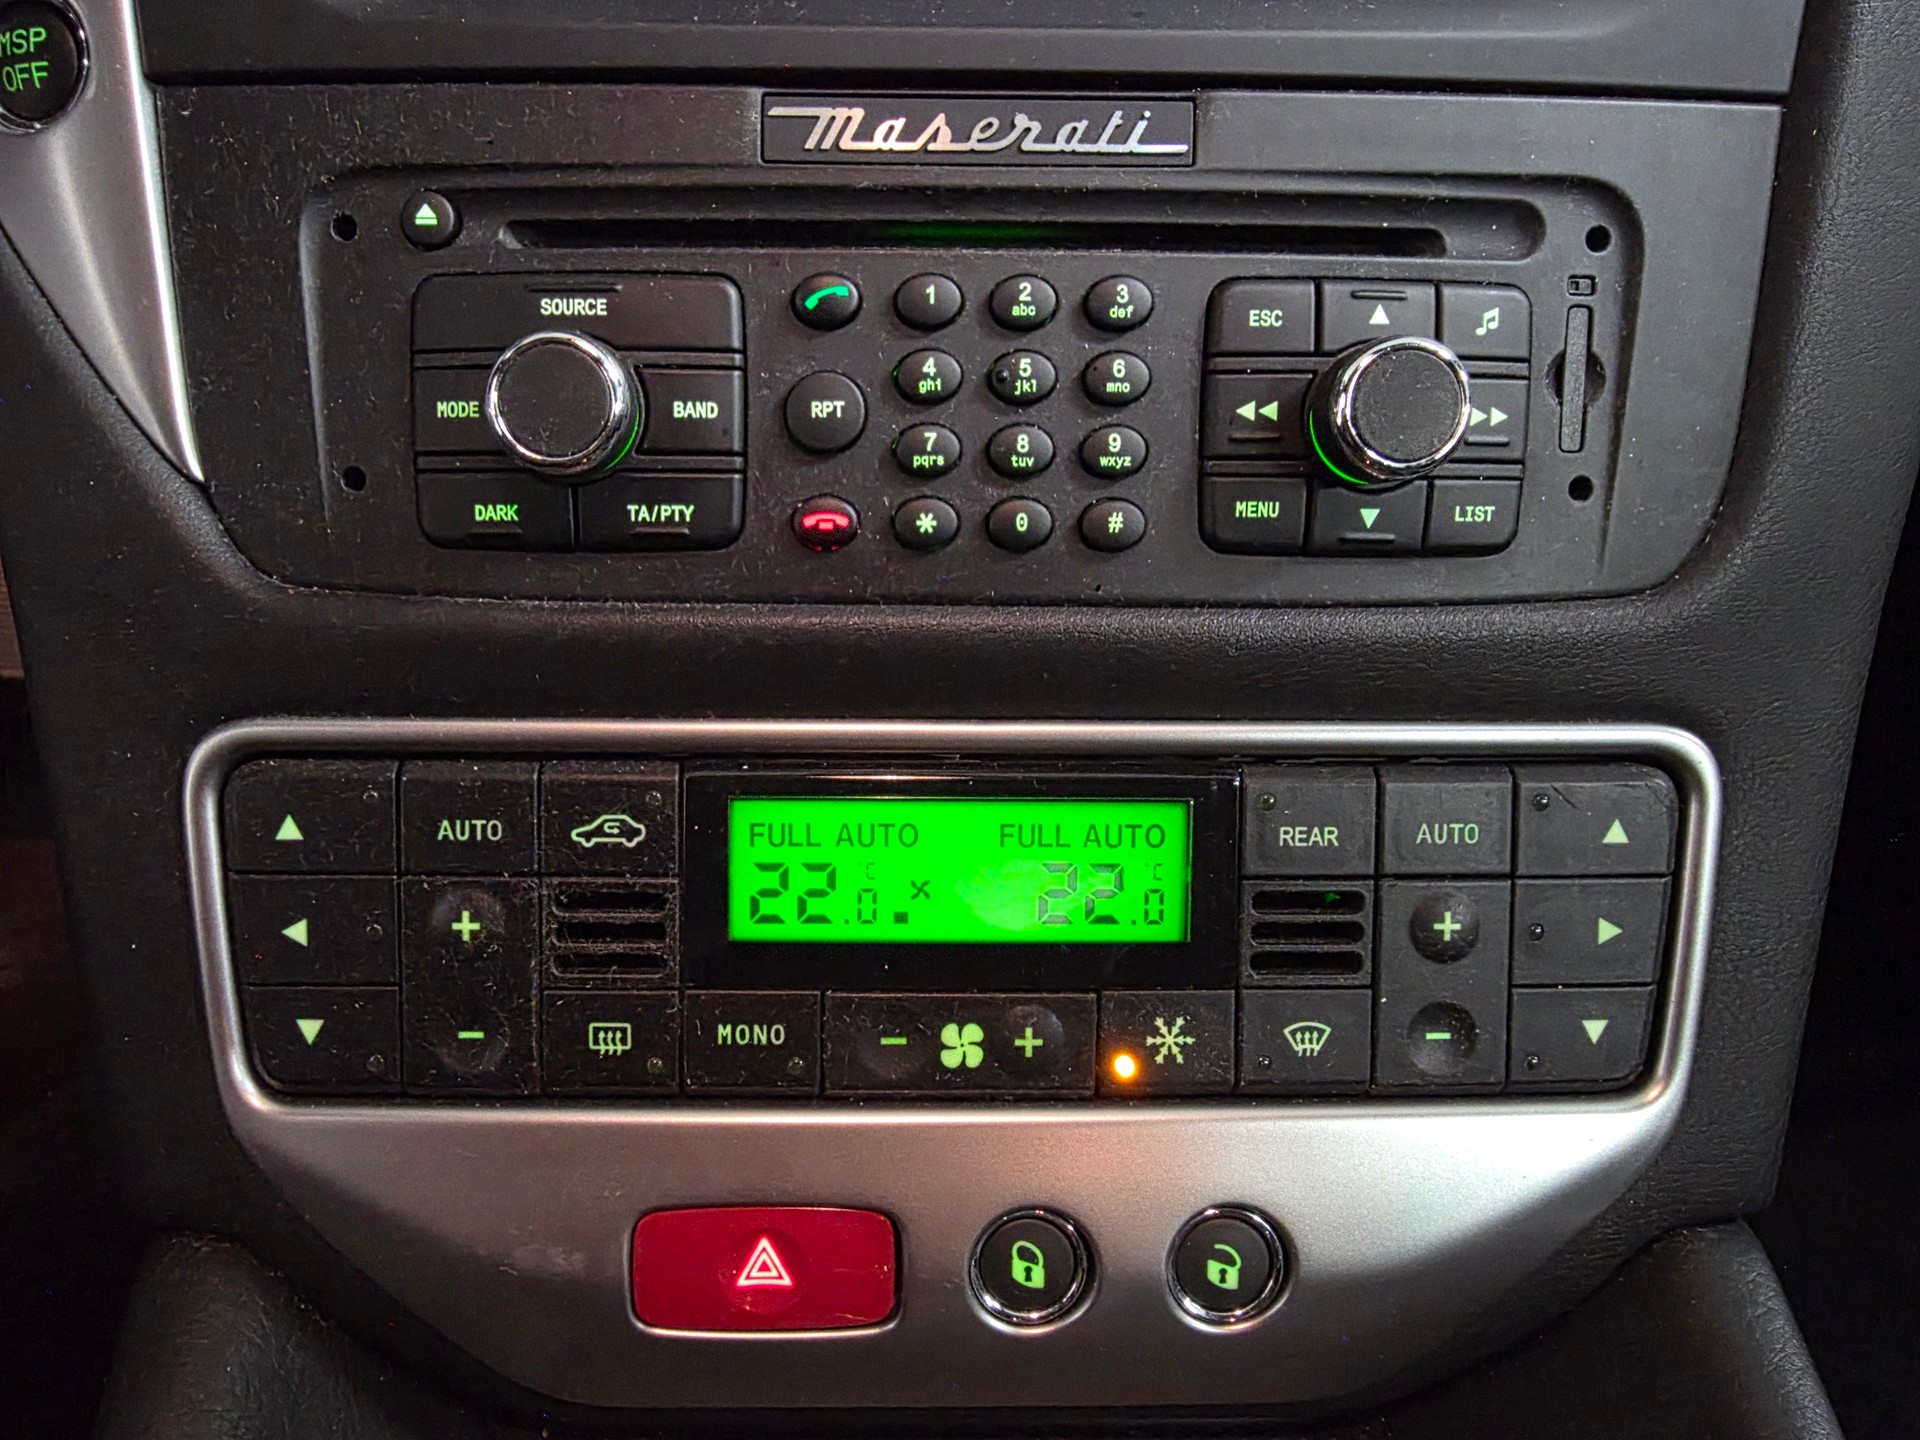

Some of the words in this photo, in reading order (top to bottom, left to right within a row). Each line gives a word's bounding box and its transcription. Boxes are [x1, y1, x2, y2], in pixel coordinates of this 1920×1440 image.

[0, 26, 47, 57] MSP
[2, 60, 49, 92] OFF
[766, 106, 1190, 155] Maserati
[925, 284, 936, 305] 1
[1018, 281, 1032, 302] 2
[1116, 283, 1130, 304] 3
[540, 297, 608, 316] SOURCE
[1011, 302, 1037, 317] abc
[1109, 304, 1135, 319] def
[1248, 309, 1283, 328] ESC
[922, 356, 937, 377] 4
[1018, 357, 1033, 378] 5
[1112, 358, 1126, 379] 6
[918, 377, 942, 394] ghi
[1014, 378, 1037, 396] jkl
[1105, 381, 1131, 393] mno
[436, 400, 480, 418] MODE
[673, 400, 719, 419] BAND
[810, 400, 846, 419] RPT
[923, 431, 938, 452] 7
[1016, 433, 1030, 454] 8
[1108, 432, 1122, 453] 9
[912, 454, 945, 469] pqrs
[1010, 454, 1035, 468] tuv
[1099, 455, 1132, 470] wxyz
[474, 504, 519, 522] DARK
[626, 504, 695, 523] TA/PTY
[1235, 500, 1280, 518] MENU
[1454, 505, 1496, 523] LIST
[1015, 512, 1029, 532] 0
[437, 819, 503, 842] AUTO
[749, 822, 822, 848] FULL
[835, 822, 919, 848] AUTO
[999, 823, 1071, 849] FULL
[1083, 823, 1166, 849] AUTO
[1279, 826, 1339, 847] REAR
[1415, 822, 1479, 845] AUTO
[717, 1023, 785, 1045] MONO
